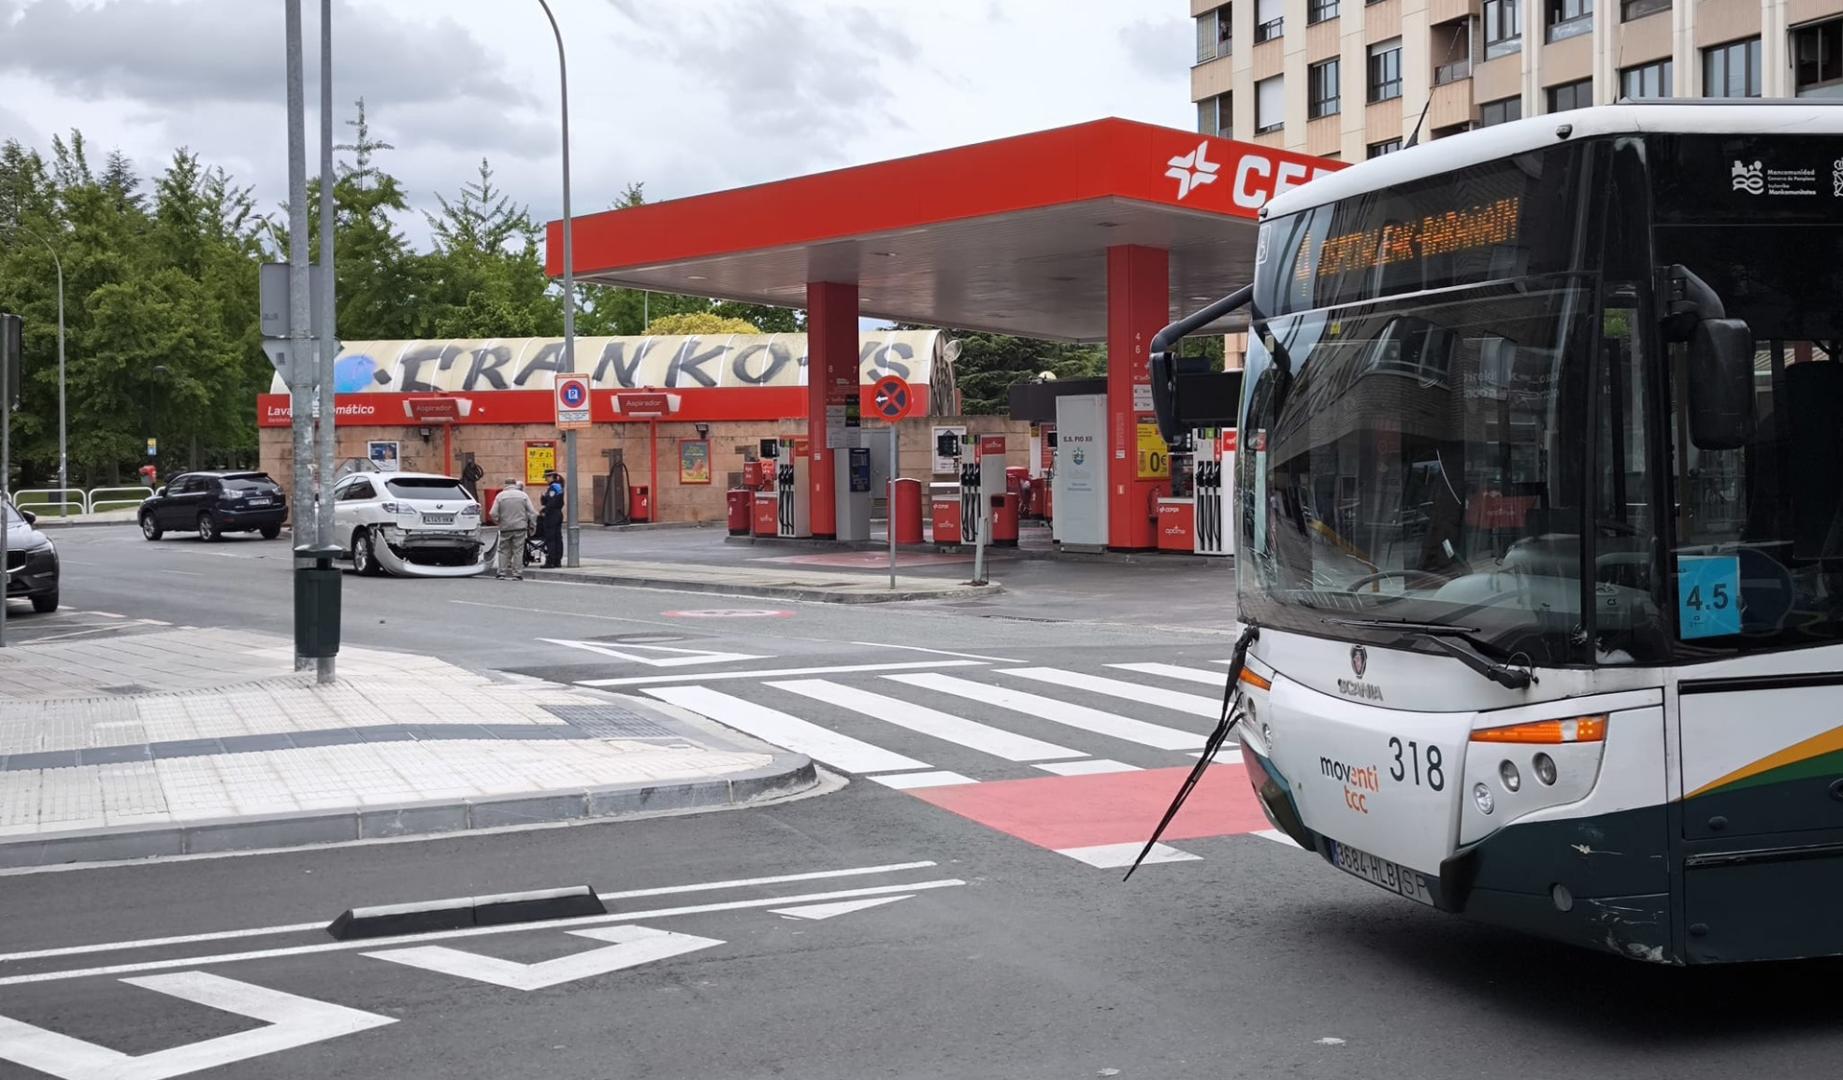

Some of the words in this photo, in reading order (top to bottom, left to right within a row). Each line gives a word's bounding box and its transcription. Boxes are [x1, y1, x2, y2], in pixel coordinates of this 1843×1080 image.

[626, 399, 661, 408] Aspirador
[1686, 583, 1728, 611] 4.5
[1337, 678, 1384, 701] SCANIA
[1320, 755, 1380, 793] moventi
[1388, 736, 1445, 792] 318
[1344, 785, 1368, 814] tcc
